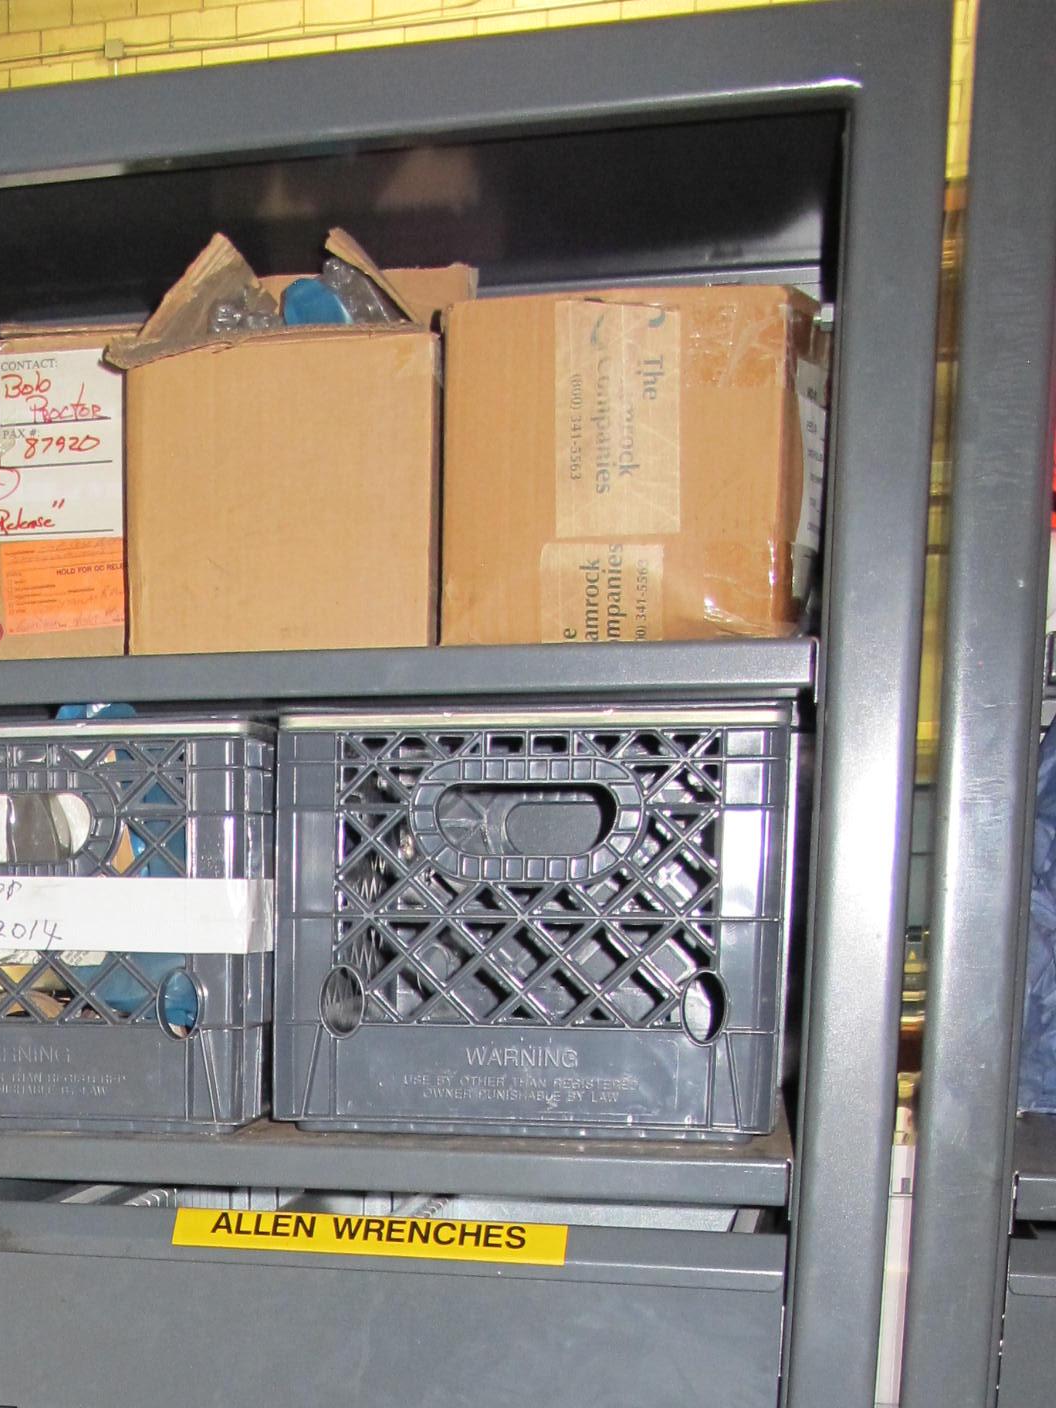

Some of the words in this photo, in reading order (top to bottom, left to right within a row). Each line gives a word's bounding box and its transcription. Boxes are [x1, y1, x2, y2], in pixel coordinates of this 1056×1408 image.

[1, 358, 58, 372] CONTACT:
[1, 370, 52, 399] Bob
[638, 355, 664, 401] The
[2, 428, 25, 440] PAX
[24, 434, 101, 460] 87920
[568, 415, 585, 481] 341-5563
[57, 568, 75, 576] HOLD
[465, 1046, 580, 1069] WARNING
[402, 1074, 430, 1086] USE
[459, 1075, 504, 1087] OTHER
[512, 1076, 547, 1088] THAN
[552, 1077, 640, 1091] REGISTERED
[423, 1088, 473, 1100] OWNER
[478, 1089, 560, 1103] PUNISHABLE
[567, 1091, 585, 1102] BY
[591, 1091, 620, 1103] LAW
[210, 1211, 317, 1240] ALLEN
[330, 1216, 528, 1251] WRENCHES
